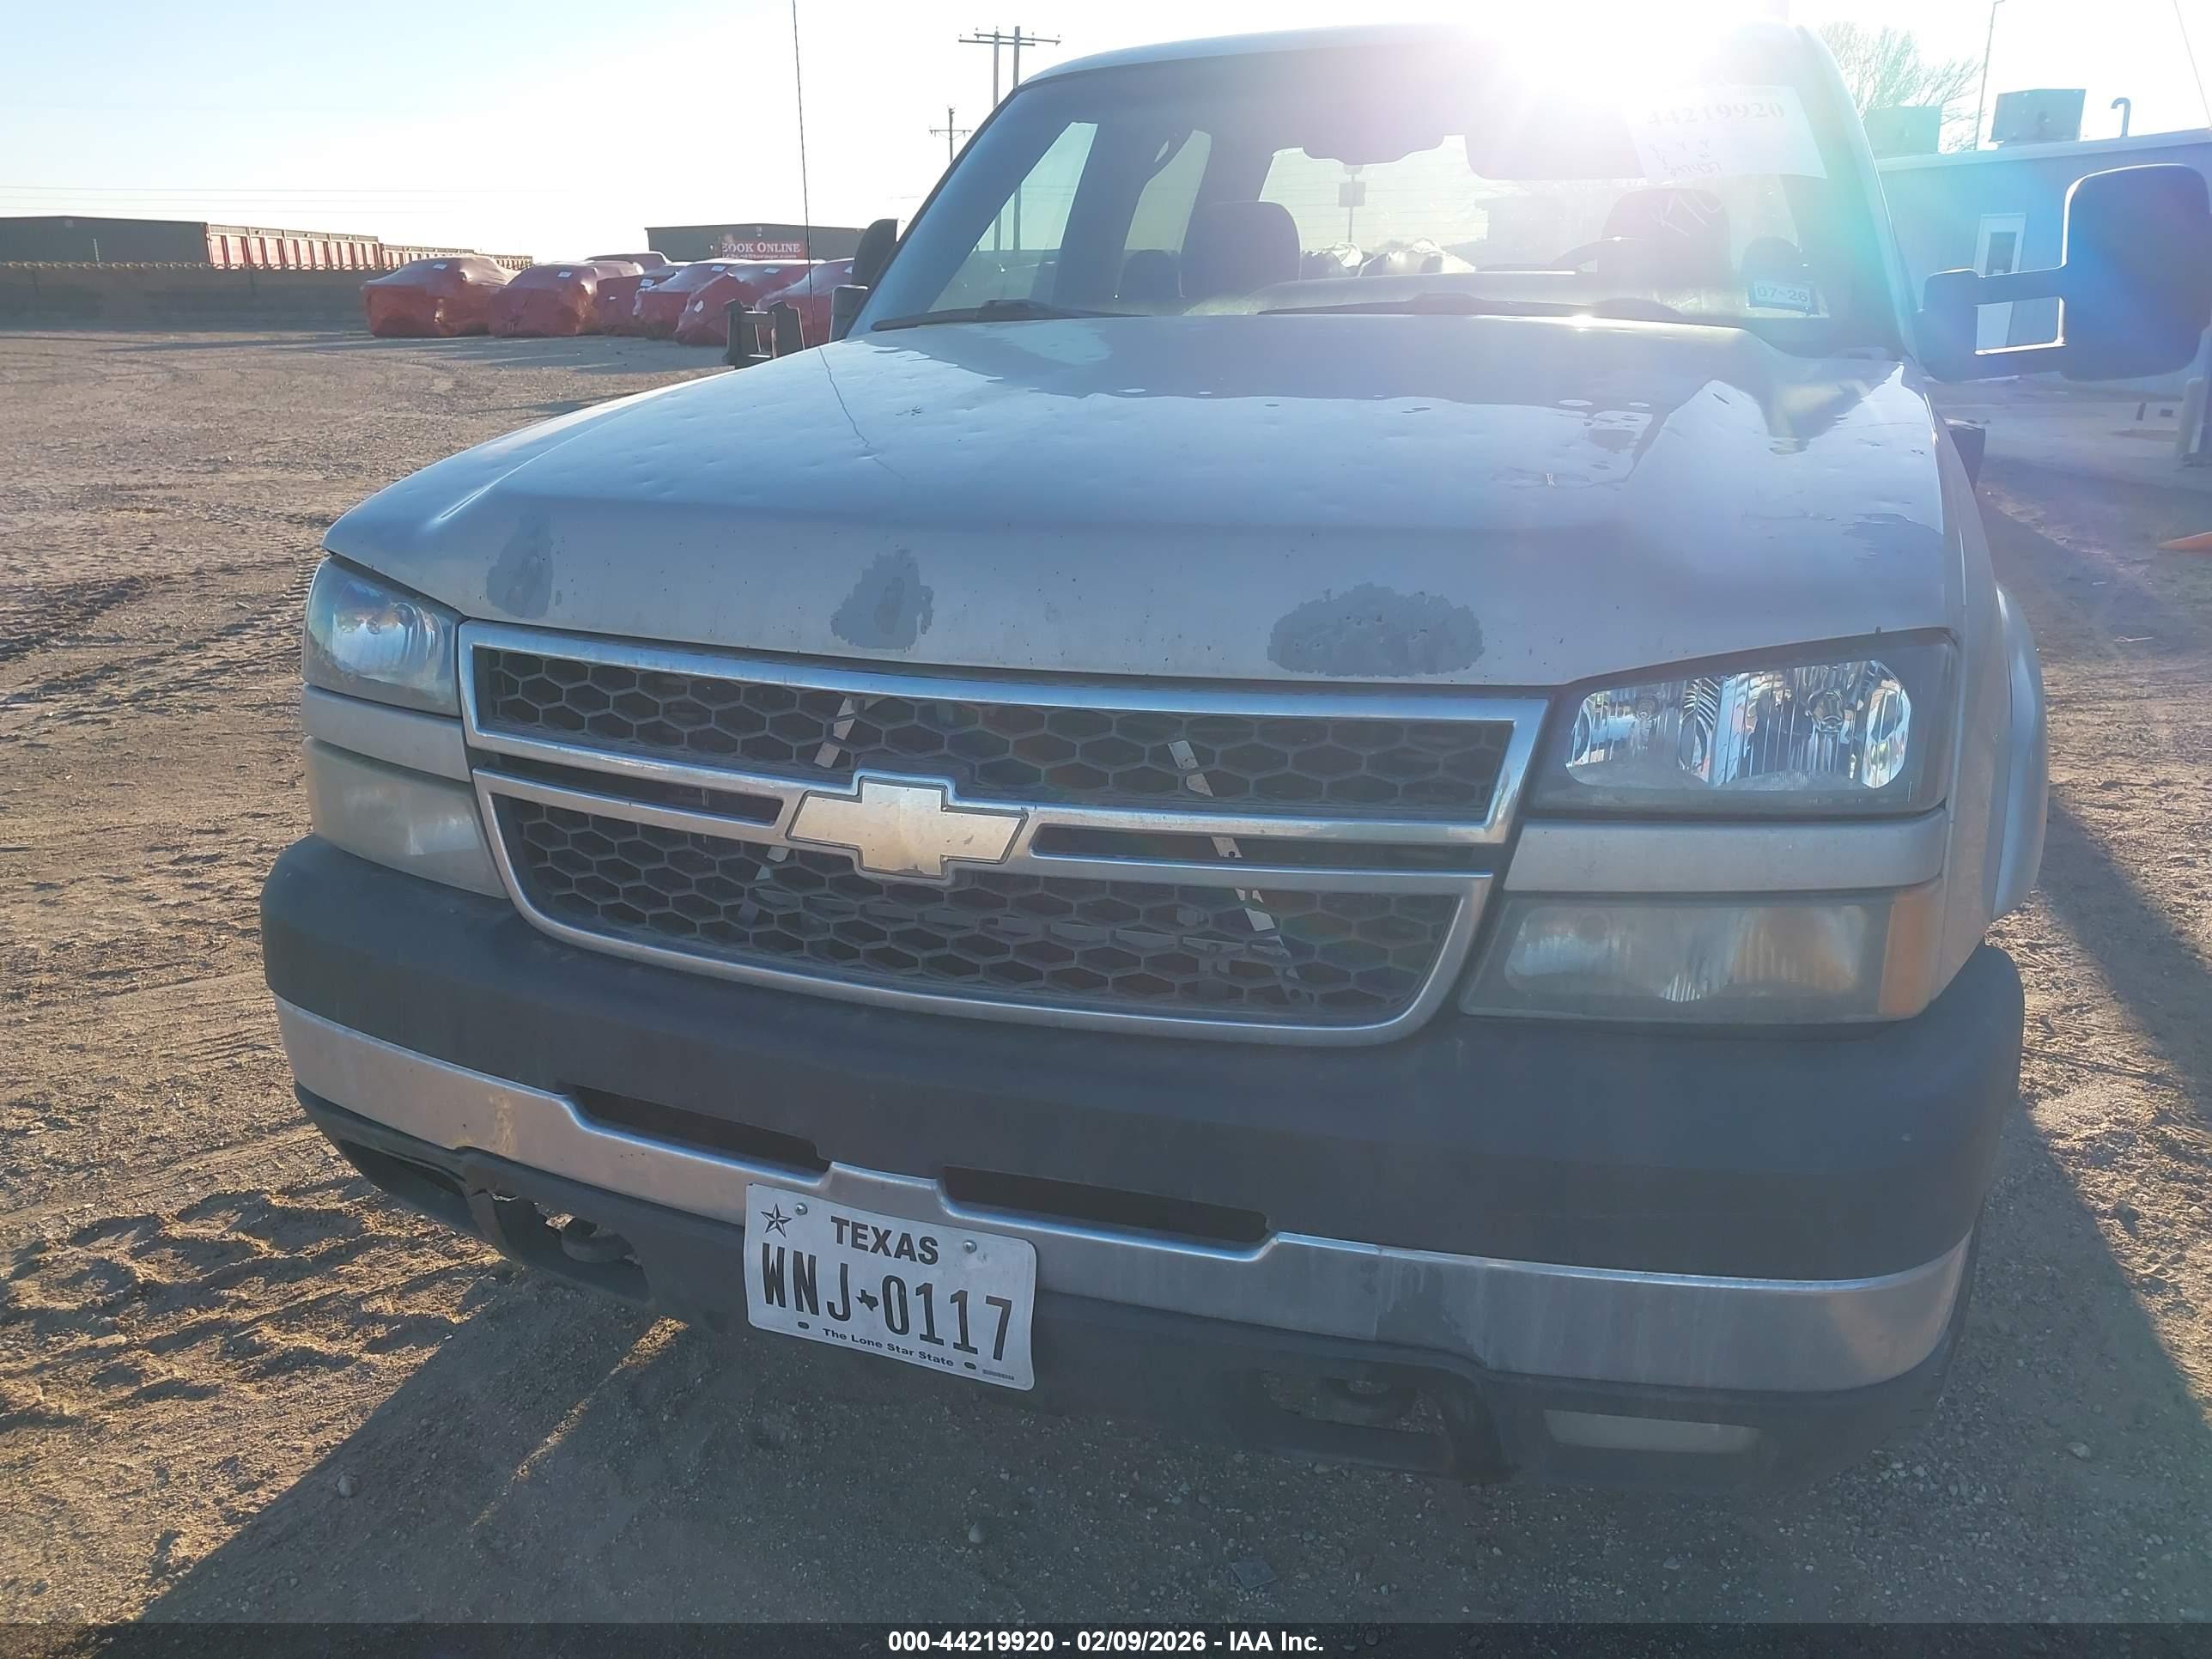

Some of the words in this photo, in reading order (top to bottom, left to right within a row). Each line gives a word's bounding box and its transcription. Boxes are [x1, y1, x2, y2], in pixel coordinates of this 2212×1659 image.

[757, 241, 801, 253] ONLINE
[830, 1215, 939, 1266] TEXAS
[762, 1243, 852, 1322] WNJ
[881, 1273, 1013, 1362] 0117
[822, 1328, 848, 1341] The
[851, 1334, 884, 1349] Lone
[887, 1343, 915, 1357] Star
[918, 1350, 955, 1367] State
